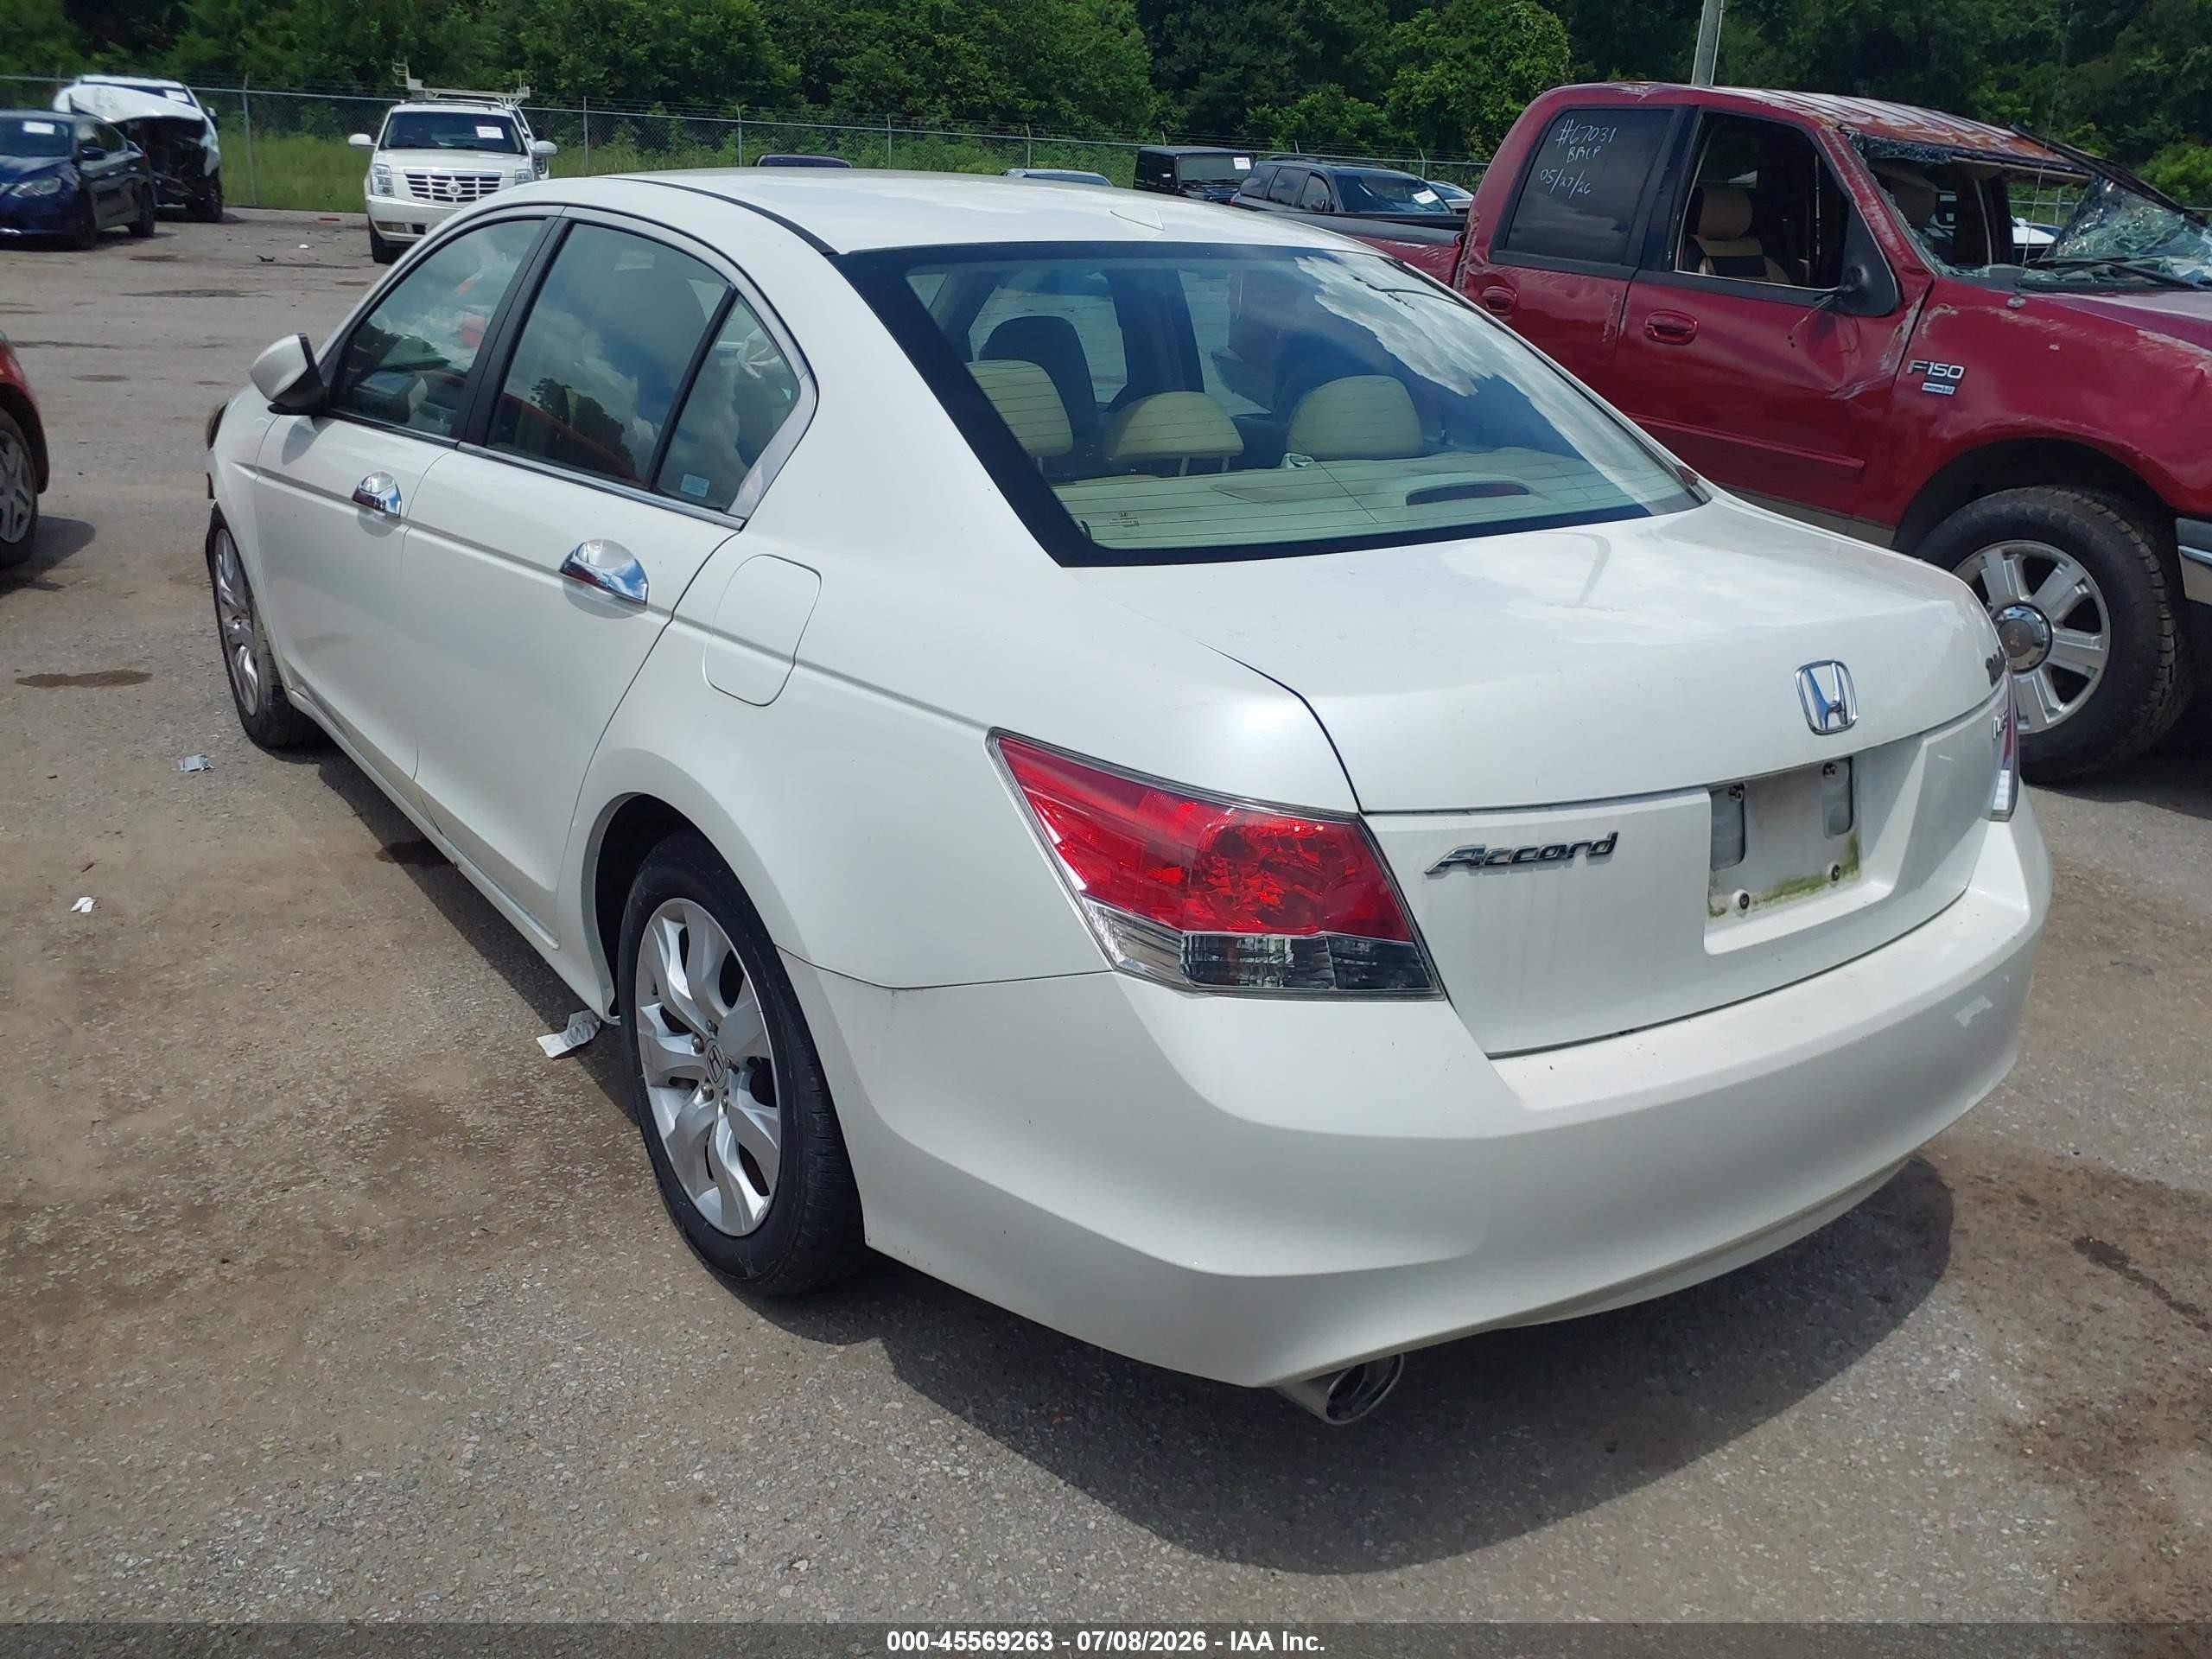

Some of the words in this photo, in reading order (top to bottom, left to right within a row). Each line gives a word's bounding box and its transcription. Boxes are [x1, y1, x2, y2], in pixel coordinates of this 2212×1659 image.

[1555, 119, 1617, 148] #67031
[1540, 168, 1592, 199] 05/27/26
[1424, 830, 1619, 874] Accord
